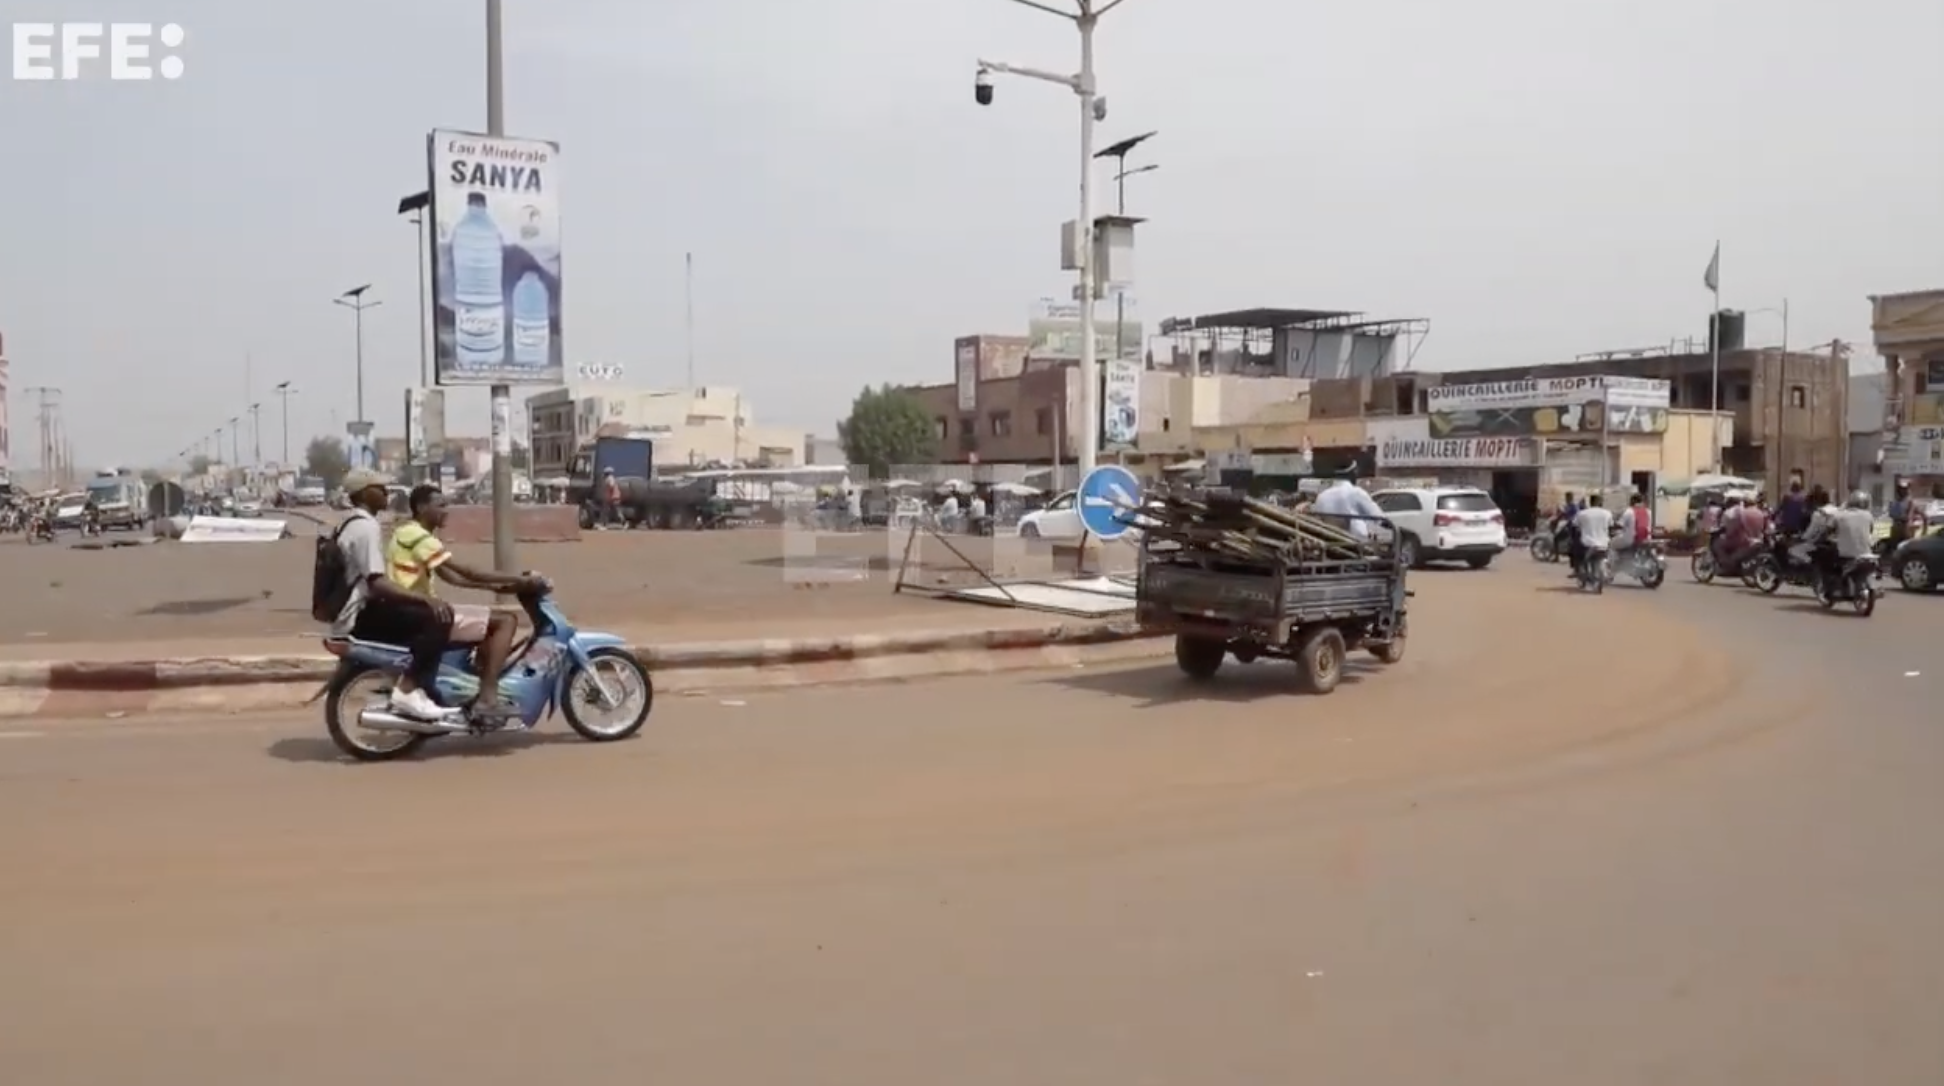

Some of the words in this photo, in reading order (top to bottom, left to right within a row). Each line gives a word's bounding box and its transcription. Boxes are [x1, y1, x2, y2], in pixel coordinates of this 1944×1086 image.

[448, 140, 476, 155] Eau
[450, 159, 542, 193] SANYA
[1549, 377, 1605, 392] MOPTI
[1474, 437, 1521, 459] MOPTI
